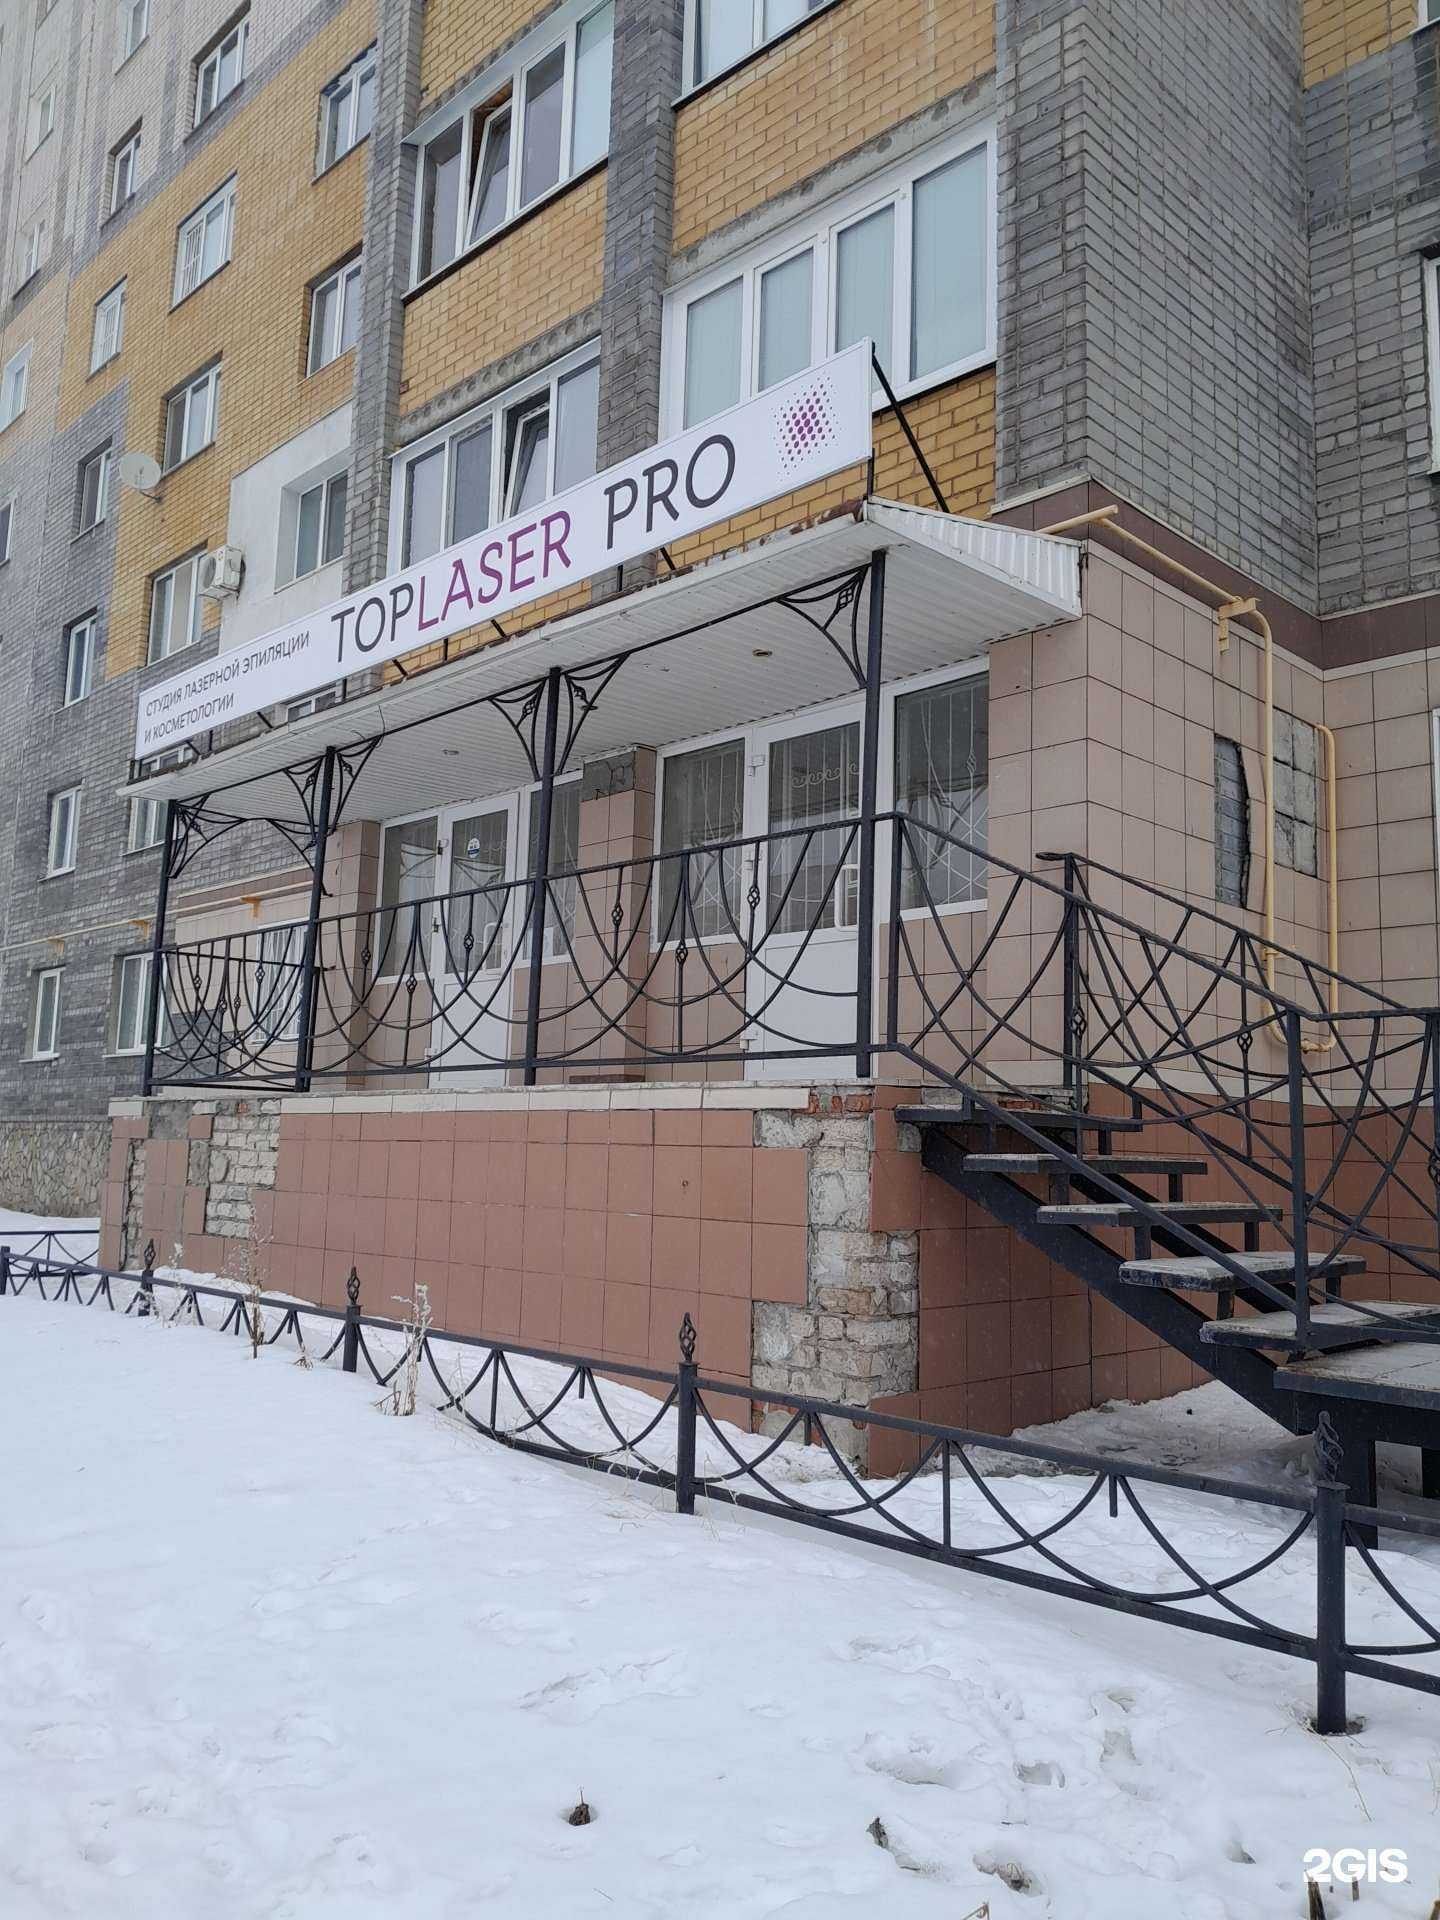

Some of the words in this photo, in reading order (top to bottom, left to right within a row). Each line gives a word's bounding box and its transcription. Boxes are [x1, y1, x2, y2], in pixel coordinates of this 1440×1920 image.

[331, 511, 571, 663] TOPLASER
[604, 434, 736, 550] PRO
[146, 687, 182, 717] СТУДИЯ
[184, 658, 240, 699] ЛАЗЕРНОЙ
[242, 631, 310, 674] ЭПИЛЯЦИИ
[144, 729, 151, 744] И
[152, 693, 234, 740] КОСМЕТОЛОГИИ
